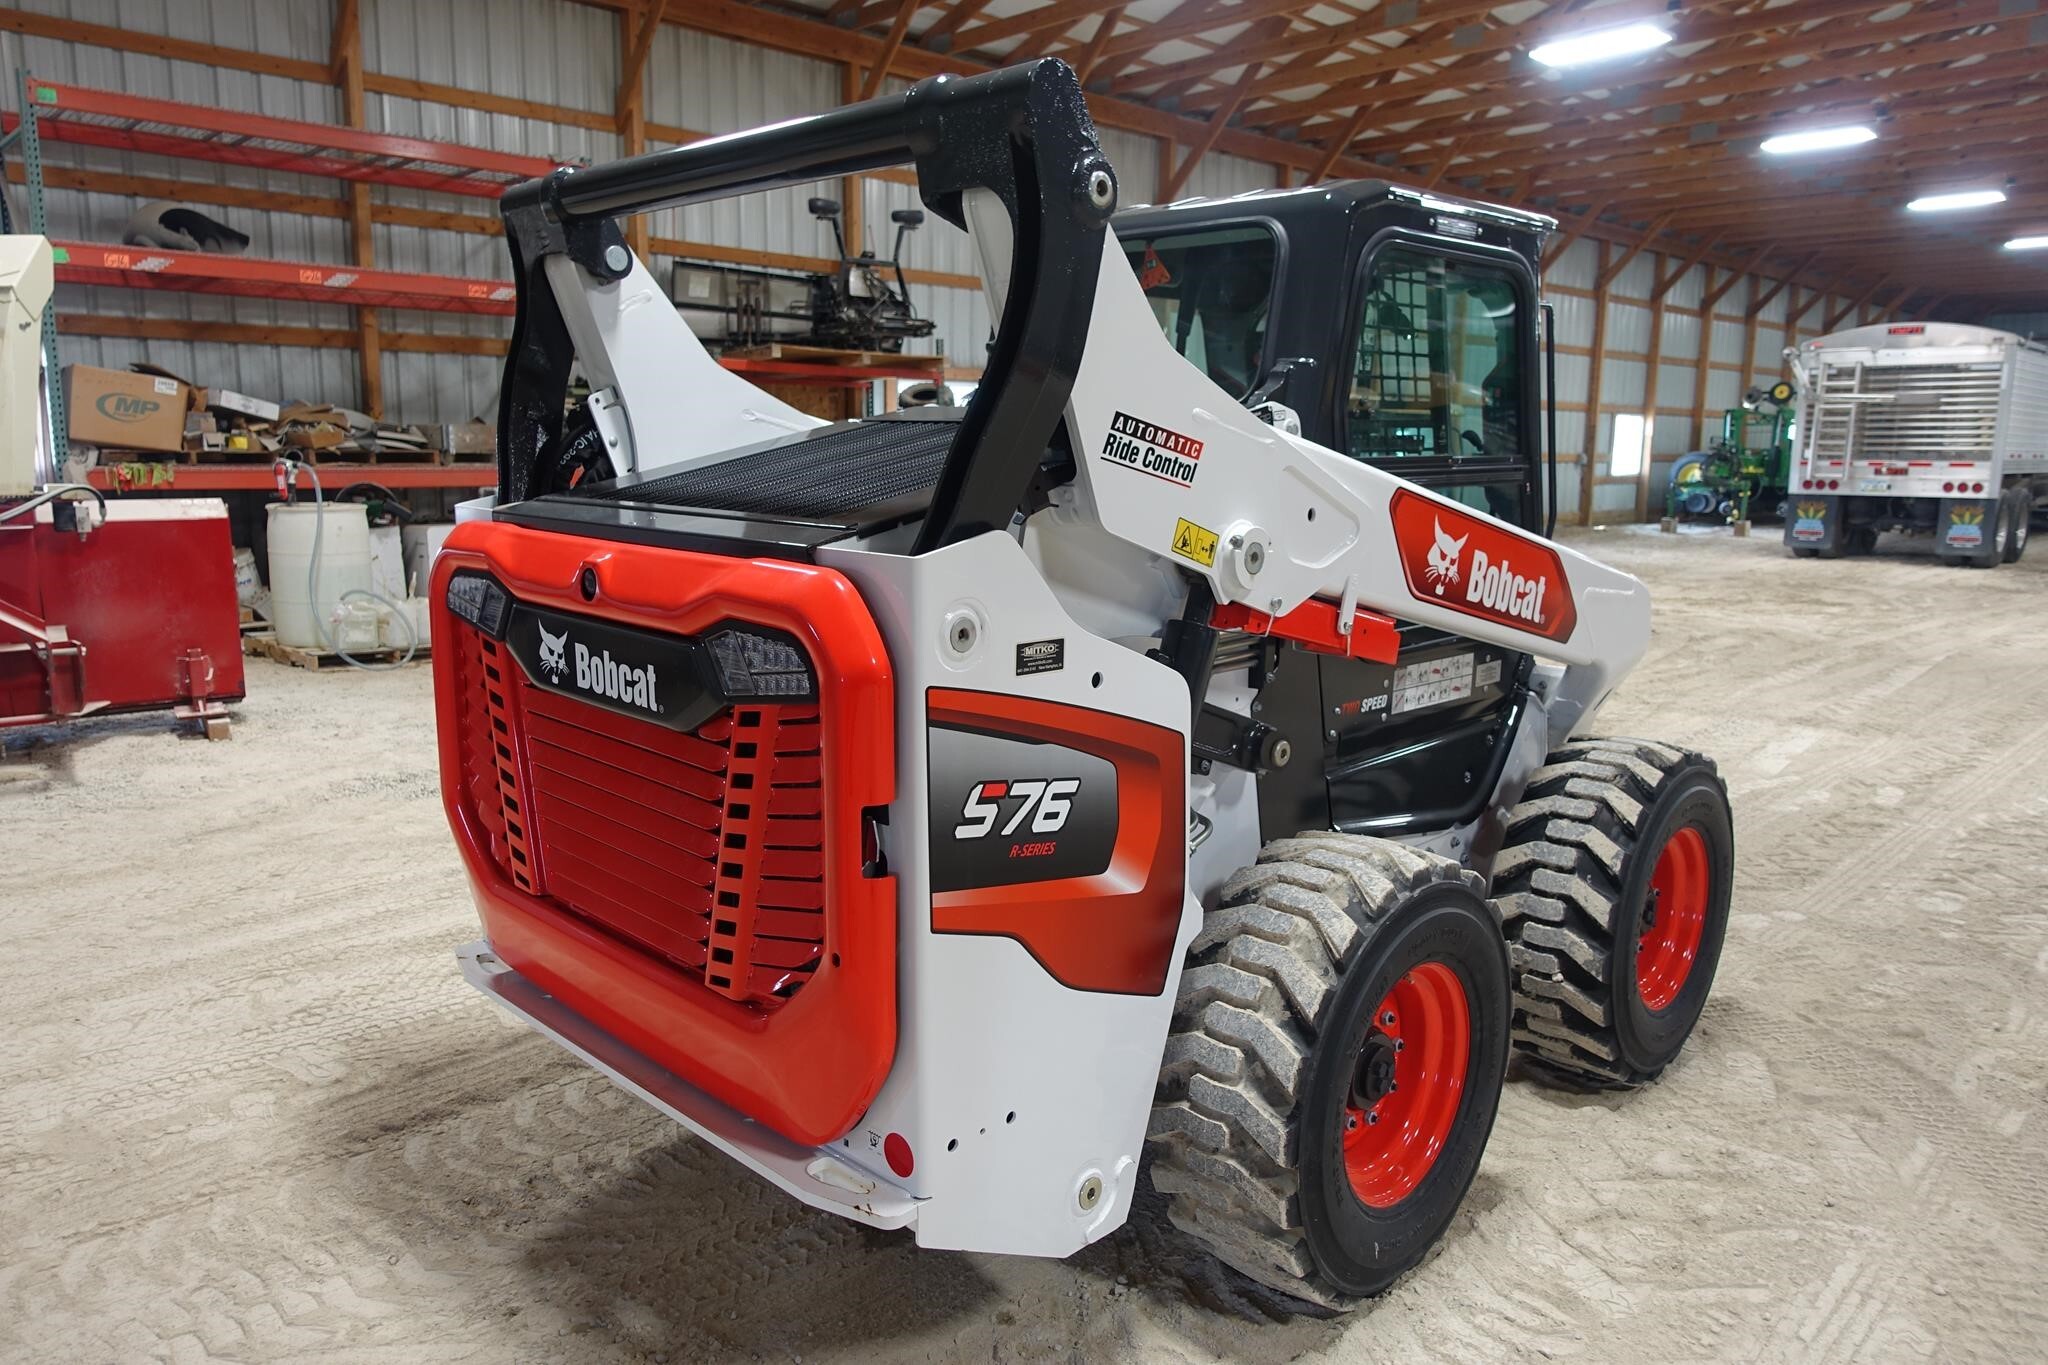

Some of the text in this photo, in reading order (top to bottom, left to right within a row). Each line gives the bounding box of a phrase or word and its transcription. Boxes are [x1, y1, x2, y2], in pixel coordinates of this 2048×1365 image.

[1102, 432, 1198, 483] Ride Control
[1114, 416, 1200, 457] AUTOMATIC
[1466, 549, 1546, 624] Bobcat
[1025, 645, 1056, 655] MITKO
[574, 642, 658, 712] Bobcat
[1361, 694, 1388, 713] SPEED
[954, 779, 1080, 839] S76
[1009, 842, 1057, 858] R-SERIES
